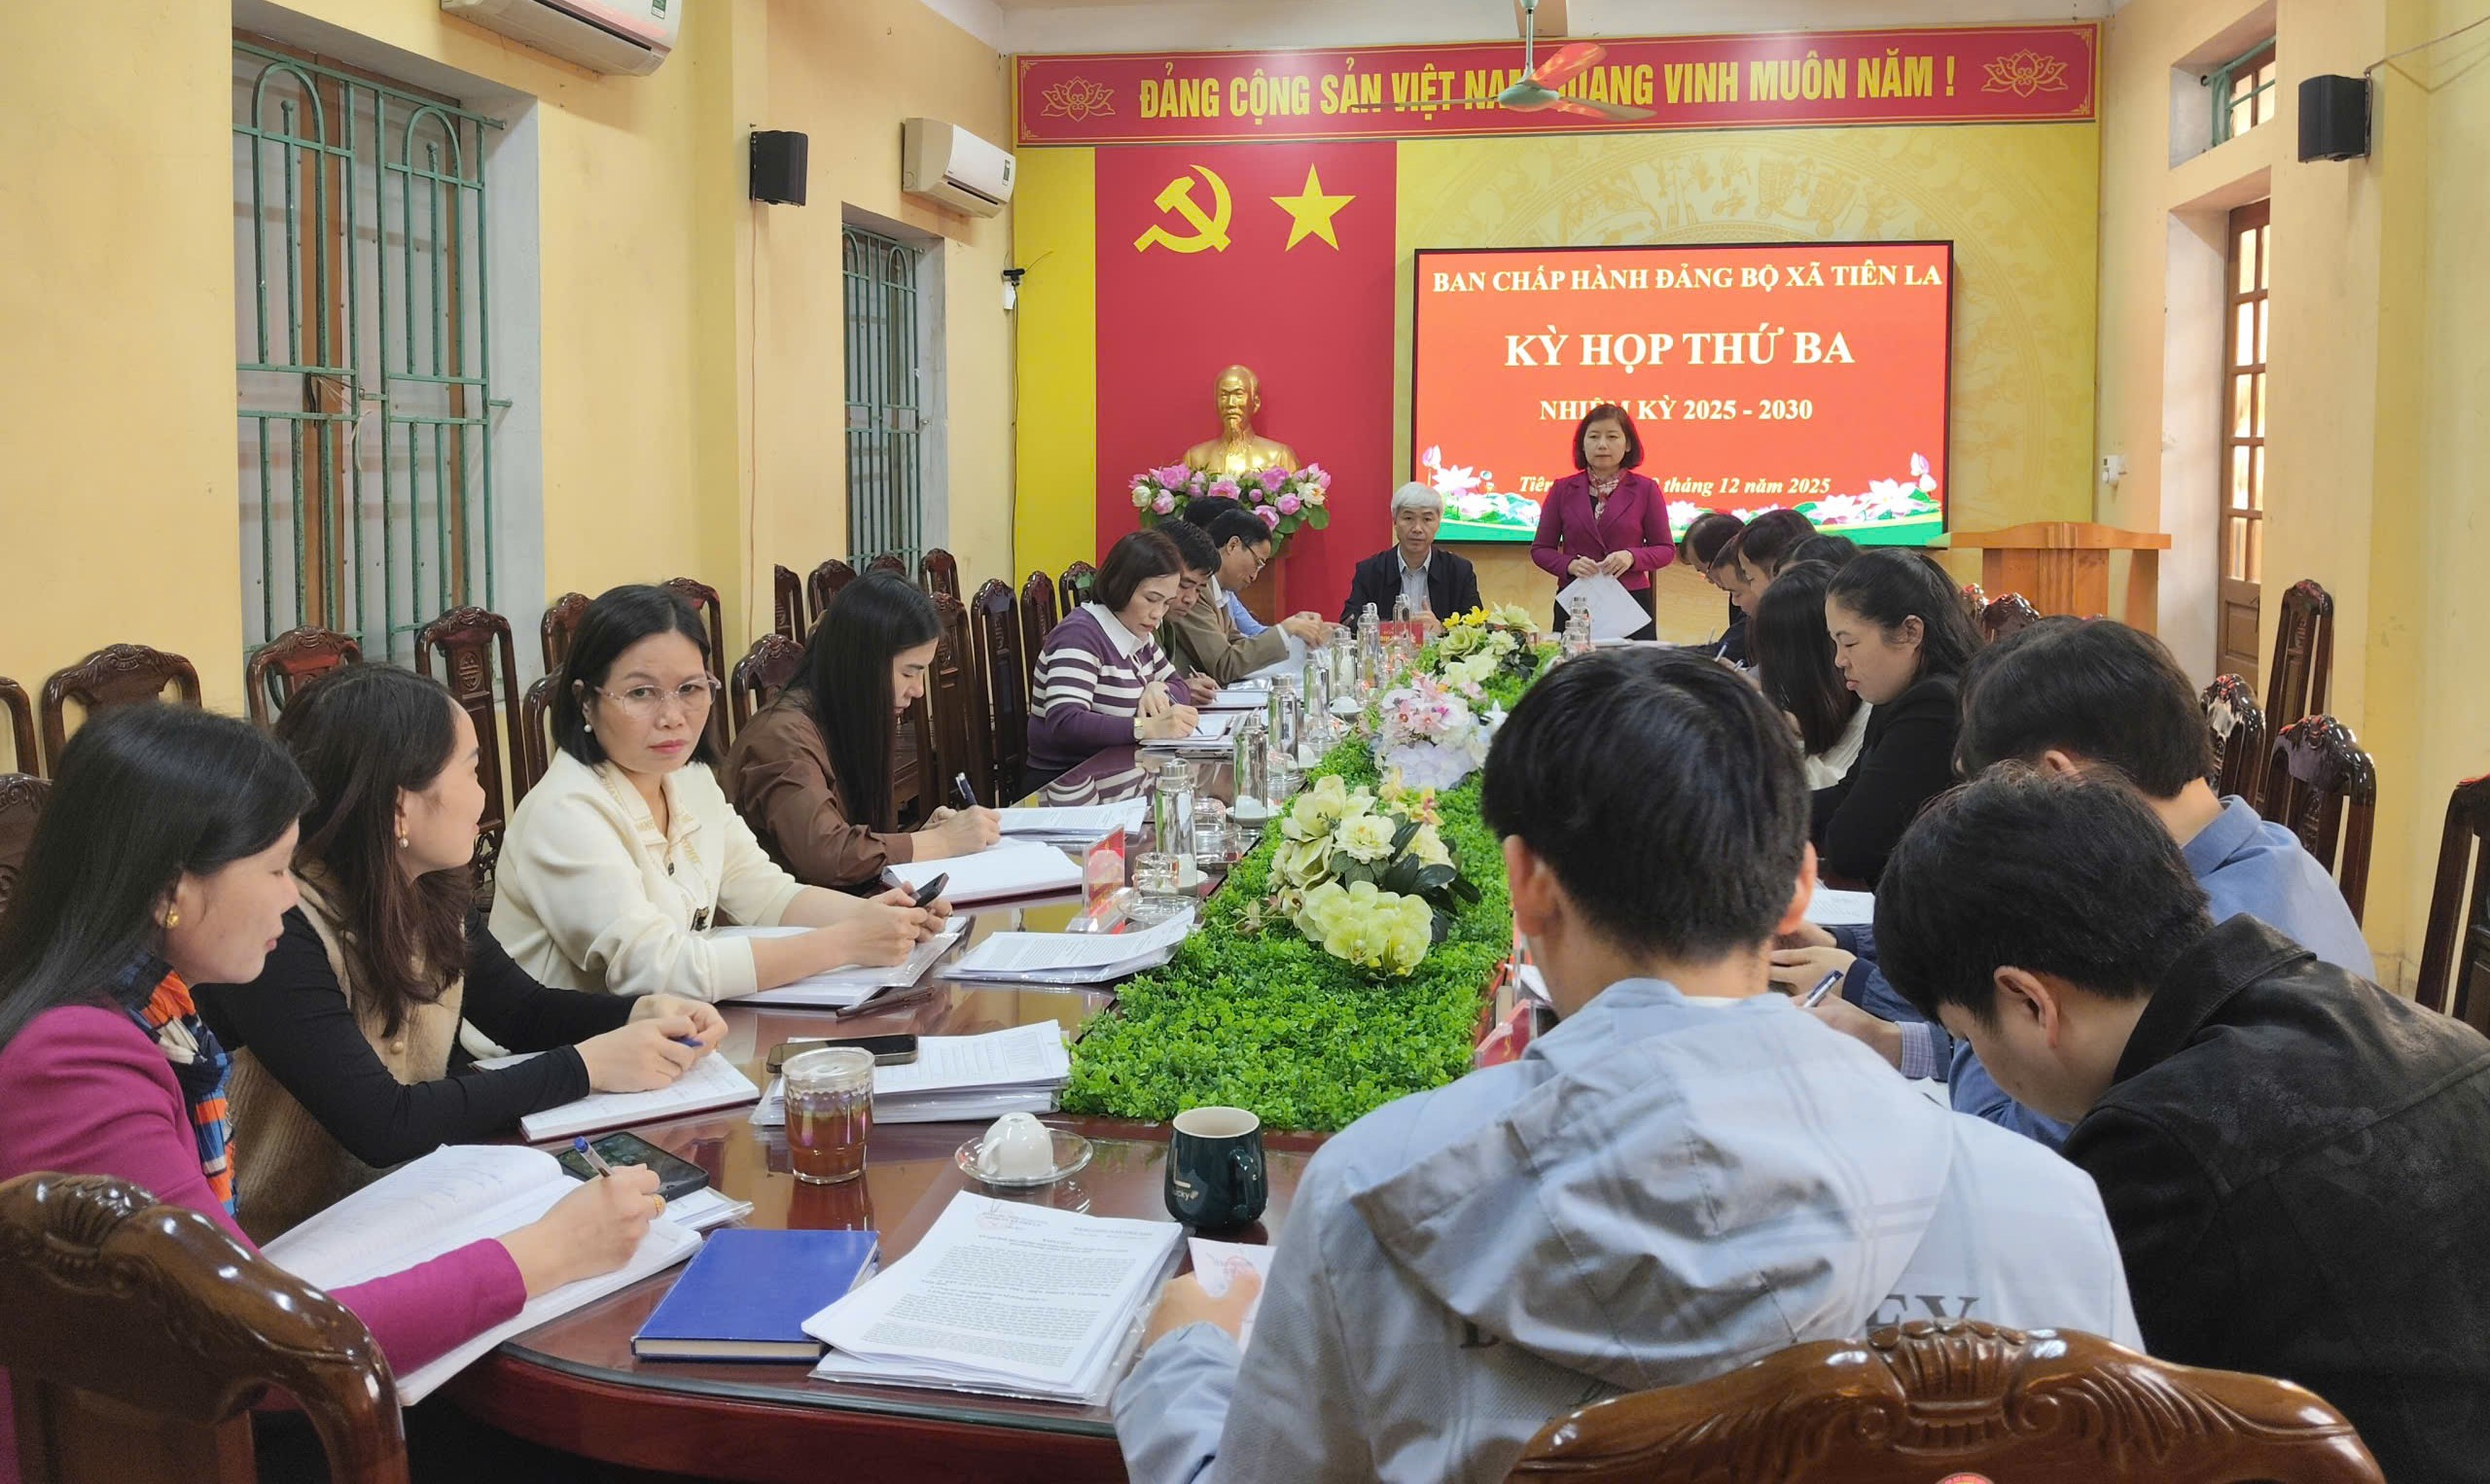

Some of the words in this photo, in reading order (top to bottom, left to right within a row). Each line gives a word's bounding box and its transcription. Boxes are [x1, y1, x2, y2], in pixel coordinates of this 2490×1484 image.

[1139, 62, 1219, 118] ĐẢNG
[1229, 70, 1309, 124] CỘNG
[1321, 57, 1381, 115] SẢN
[1393, 63, 1454, 120] VIỆT
[1664, 62, 1738, 103] VINH
[1750, 51, 1845, 100] MUÔN
[1857, 49, 1933, 98] NĂM
[1945, 56, 1955, 96] !
[1433, 271, 1485, 292] BAN
[1492, 265, 1565, 291] CHẤP
[1571, 264, 1649, 290] HÀNH
[1655, 263, 1733, 289] ĐẢNG
[1741, 264, 1779, 292] BỘ
[1787, 262, 1824, 286] XÃ
[1830, 259, 1897, 286] TIÊN
[1904, 265, 1942, 285] LA
[1504, 324, 1569, 366] KỲ
[1579, 334, 1673, 374] HỌP
[1683, 323, 1784, 365] THỨ
[1793, 332, 1856, 364] BA
[1638, 394, 1677, 420] KỲ
[1684, 399, 1737, 420] 2025
[1759, 399, 1813, 420] 2030
[1663, 477, 1714, 497] tháng
[1719, 477, 1740, 494] 12
[1744, 477, 1784, 494] năm
[1788, 477, 1832, 494] 2025
